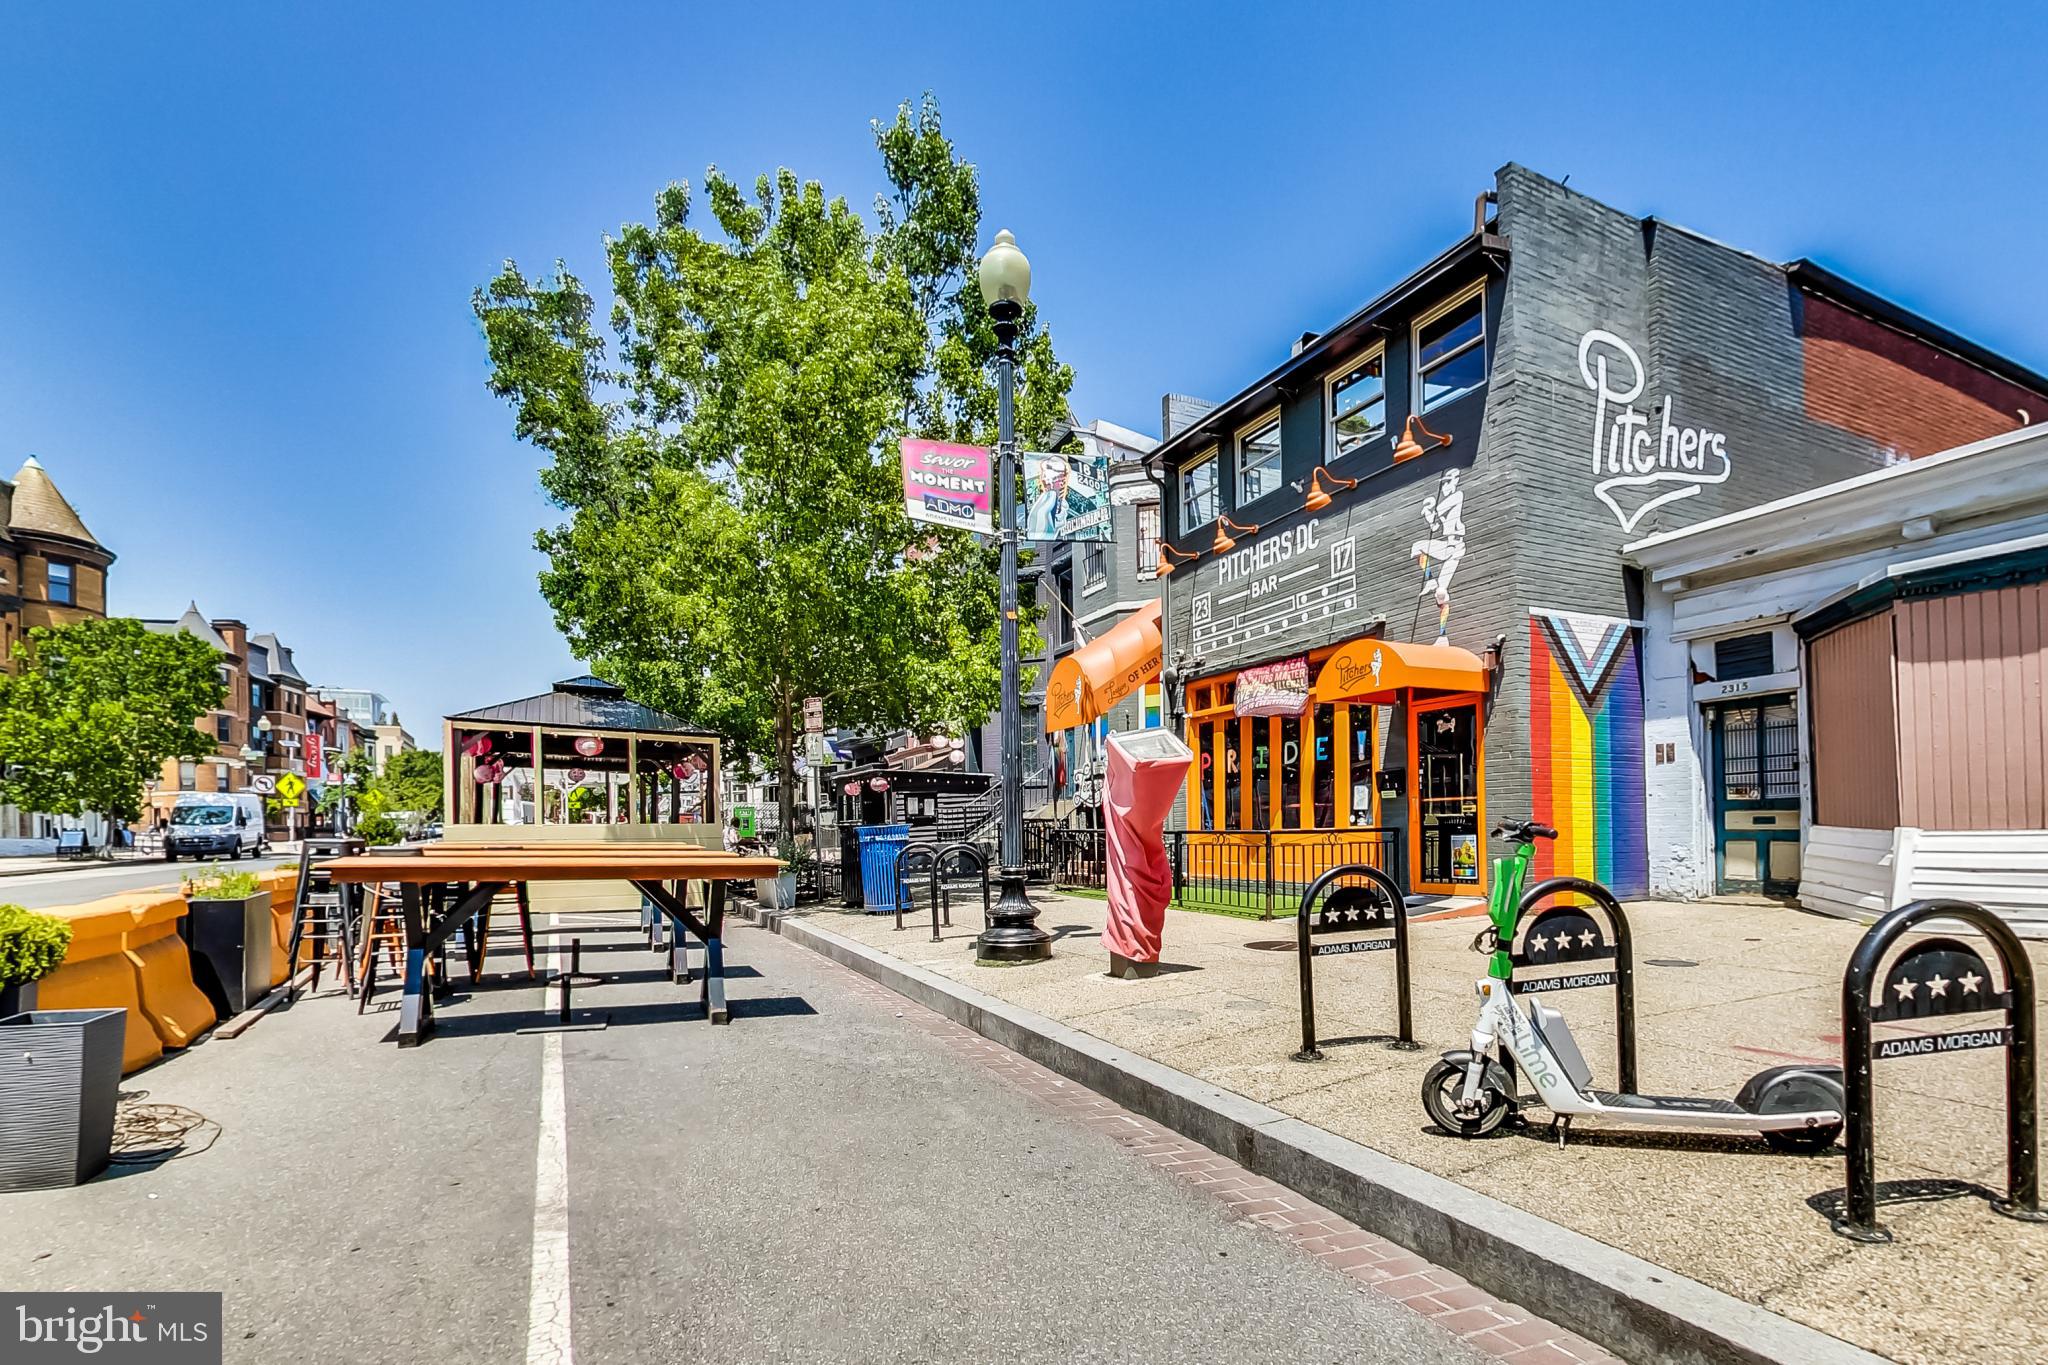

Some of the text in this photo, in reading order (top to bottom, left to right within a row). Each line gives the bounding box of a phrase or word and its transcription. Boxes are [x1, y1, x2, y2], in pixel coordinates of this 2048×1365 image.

[1578, 329, 1731, 485] Pitchers
[910, 470, 985, 493] MOMENT
[926, 497, 974, 518] ADMO
[1218, 518, 1320, 586] PITCHERS DC
[1334, 542, 1352, 571] 17
[1251, 574, 1278, 599] BAR
[1195, 598, 1209, 621] 23
[1128, 670, 1140, 683] OF
[1140, 657, 1160, 674] HER
[1336, 656, 1373, 686] Pitchers
[1721, 682, 1749, 694] 2315
[1318, 940, 1391, 955] ADAMS MORGAN
[1522, 973, 1610, 993] ADAMS MORGAN
[1880, 1031, 2001, 1057] ADAMS MORGAN
[1517, 1032, 1558, 1089] Lime
